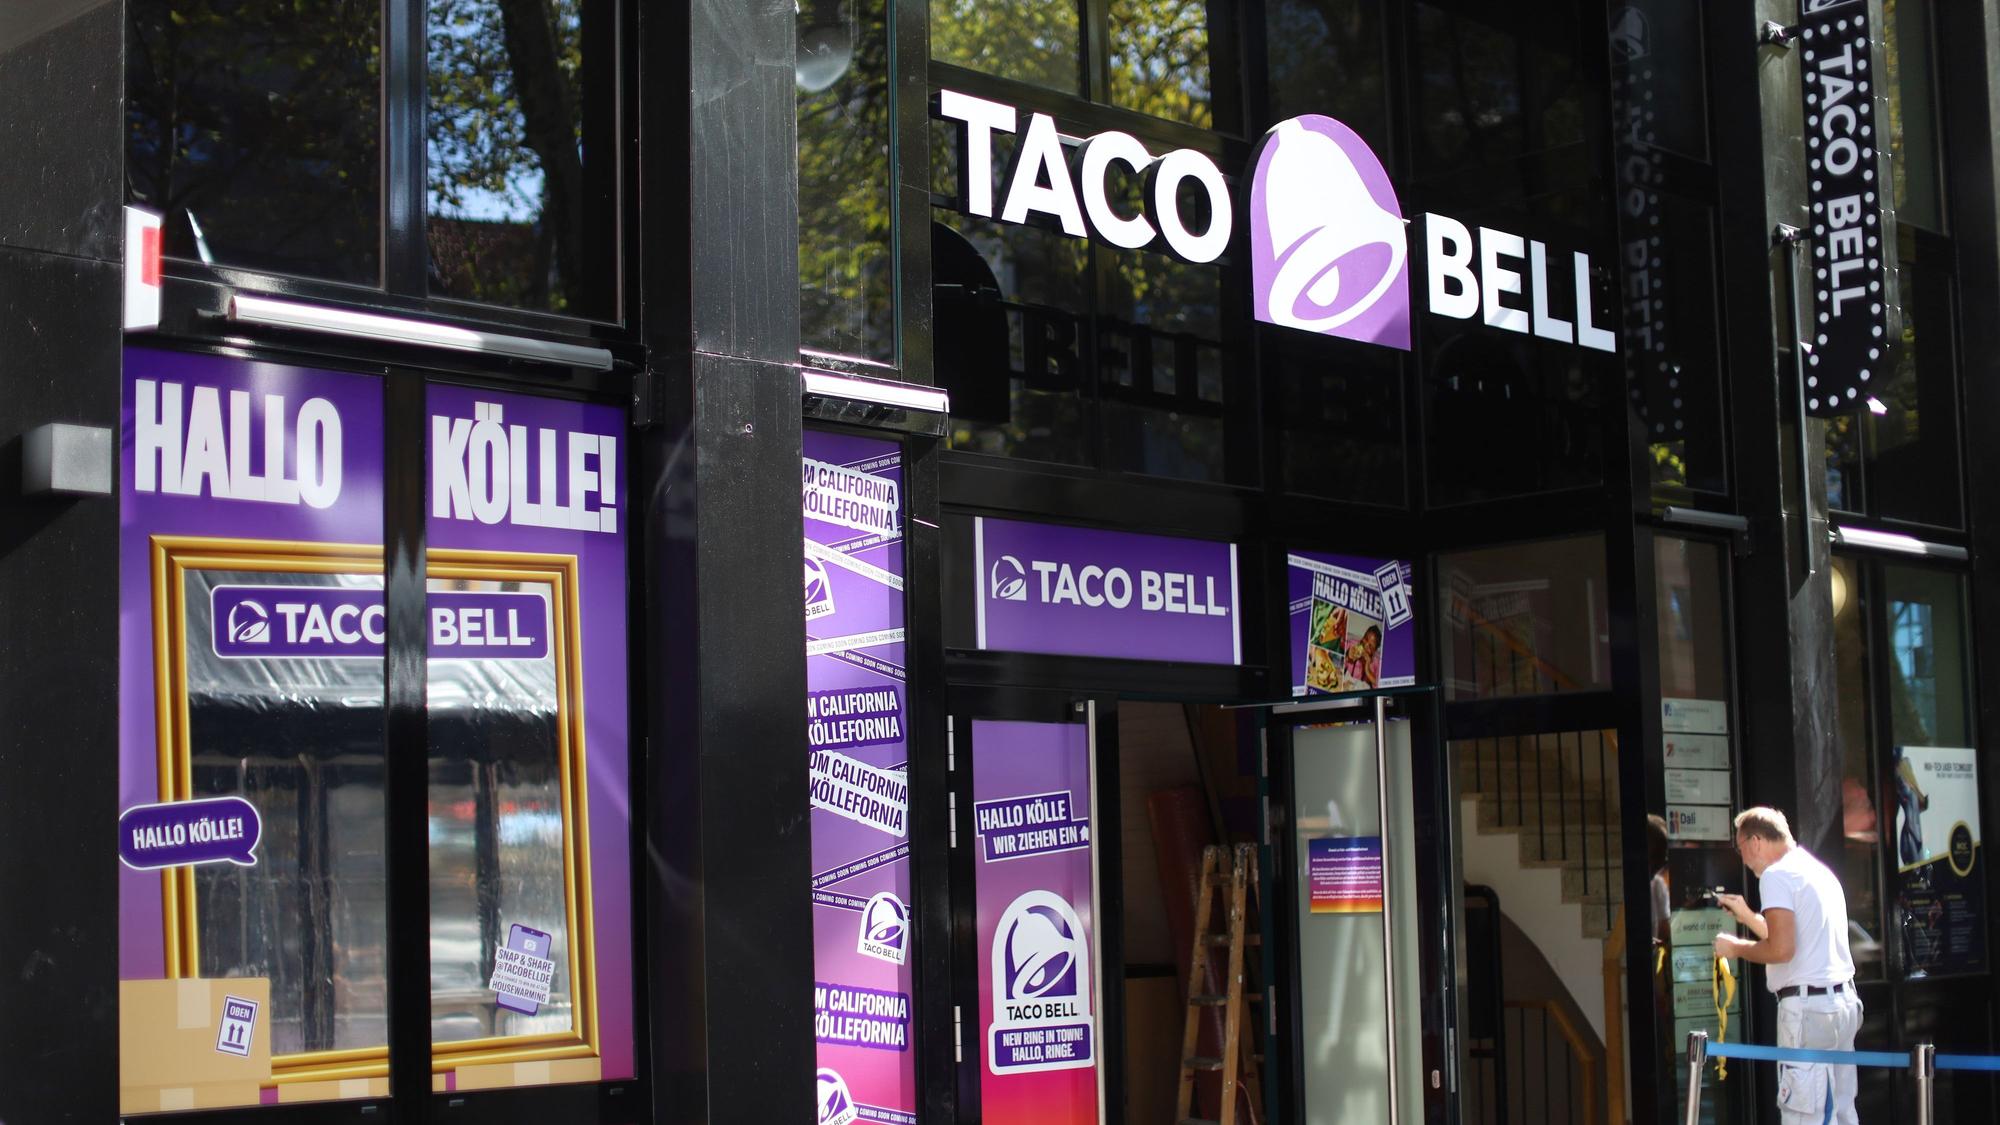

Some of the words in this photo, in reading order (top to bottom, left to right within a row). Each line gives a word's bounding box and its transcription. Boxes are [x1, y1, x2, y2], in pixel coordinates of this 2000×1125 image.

[1819, 43, 1859, 176] TACO
[941, 88, 1232, 264] TACO
[1424, 211, 1616, 353] BELL
[1827, 194, 1866, 318] BELL
[135, 379, 341, 509] HALLO
[432, 401, 617, 533] KÖLLE!
[860, 462, 878, 472] COMING
[879, 458, 890, 467] SOON
[819, 468, 894, 504] CALIFORNIA
[1032, 560, 1132, 608] TACO
[1140, 570, 1226, 616] BELL
[1316, 572, 1349, 606] HALLO
[1382, 572, 1397, 588] OBEN
[276, 604, 384, 644] TACO
[433, 608, 532, 646] BELL
[812, 605, 829, 616] BELL
[845, 652, 864, 664] COMING
[864, 658, 876, 668] SOON
[876, 662, 894, 674] COMING
[820, 690, 898, 718] CALIFORNIA
[808, 716, 900, 746] KÖLLEFORNIA
[832, 759, 907, 805] CALIFORNIA
[810, 777, 902, 830] KÖLLEFORNIA
[980, 806, 1023, 831] HALLO
[1026, 799, 1067, 824] KÖLLE
[133, 823, 186, 850] HALLO
[189, 818, 243, 843] KÖLLE!
[993, 834, 1016, 854] WIR
[1018, 829, 1058, 850] ZIEHEN
[1059, 825, 1078, 845] EIN
[818, 873, 837, 884] COMING
[837, 868, 850, 878] SOON
[850, 862, 867, 872] COMING
[867, 857, 880, 866] SOON
[880, 851, 897, 862] COMING
[816, 893, 834, 903] COMING
[835, 897, 847, 905] SOON
[848, 899, 866, 908] COMING
[498, 949, 519, 963] SNAP
[520, 955, 526, 965] &
[527, 958, 552, 973] SHARE
[864, 942, 881, 955] TACO
[882, 948, 901, 960] BELL
[497, 962, 550, 984] @TACOBELLDE
[492, 981, 546, 1002] HOUSEWARMING
[829, 990, 907, 1019] CALIFORNIA
[230, 1005, 250, 1019] OBEN
[1006, 1005, 1042, 1020] TACO
[1045, 1002, 1077, 1018] BELL
[1003, 1032, 1022, 1047] NEW
[1024, 1030, 1044, 1045] RING
[1046, 1030, 1055, 1043] IN
[1056, 1028, 1083, 1042] TOWN!
[1012, 1045, 1044, 1062] HALLO,
[1046, 1043, 1075, 1059] RINGE.
[860, 1108, 877, 1118] COMING
[878, 1111, 890, 1120] SOON
[890, 1114, 908, 1123] COMING
